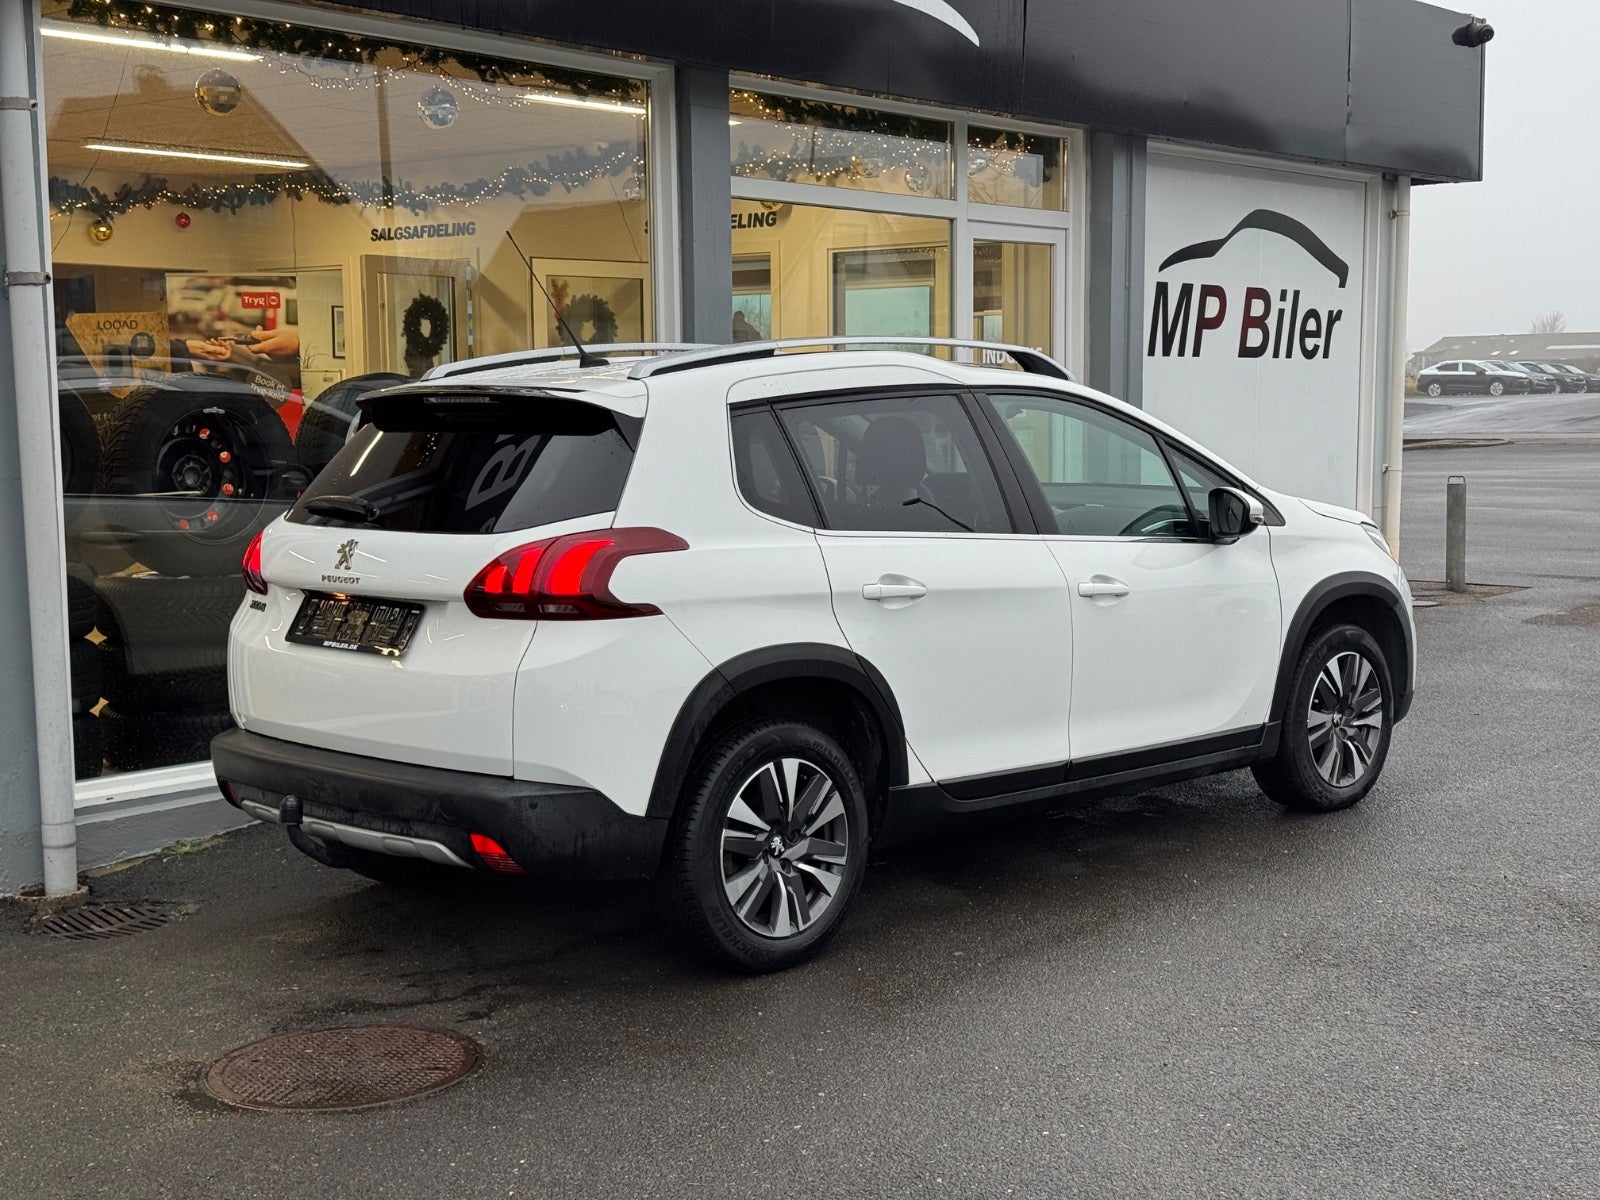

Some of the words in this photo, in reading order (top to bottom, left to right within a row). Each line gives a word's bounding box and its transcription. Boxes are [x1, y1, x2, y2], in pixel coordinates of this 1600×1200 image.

[370, 221, 476, 242] SALGSAFDELING
[243, 295, 265, 306] Tryg
[1147, 281, 1228, 358] MP
[1237, 286, 1343, 360] Biler
[255, 374, 276, 389] Book
[321, 574, 361, 585] PEUGEOT
